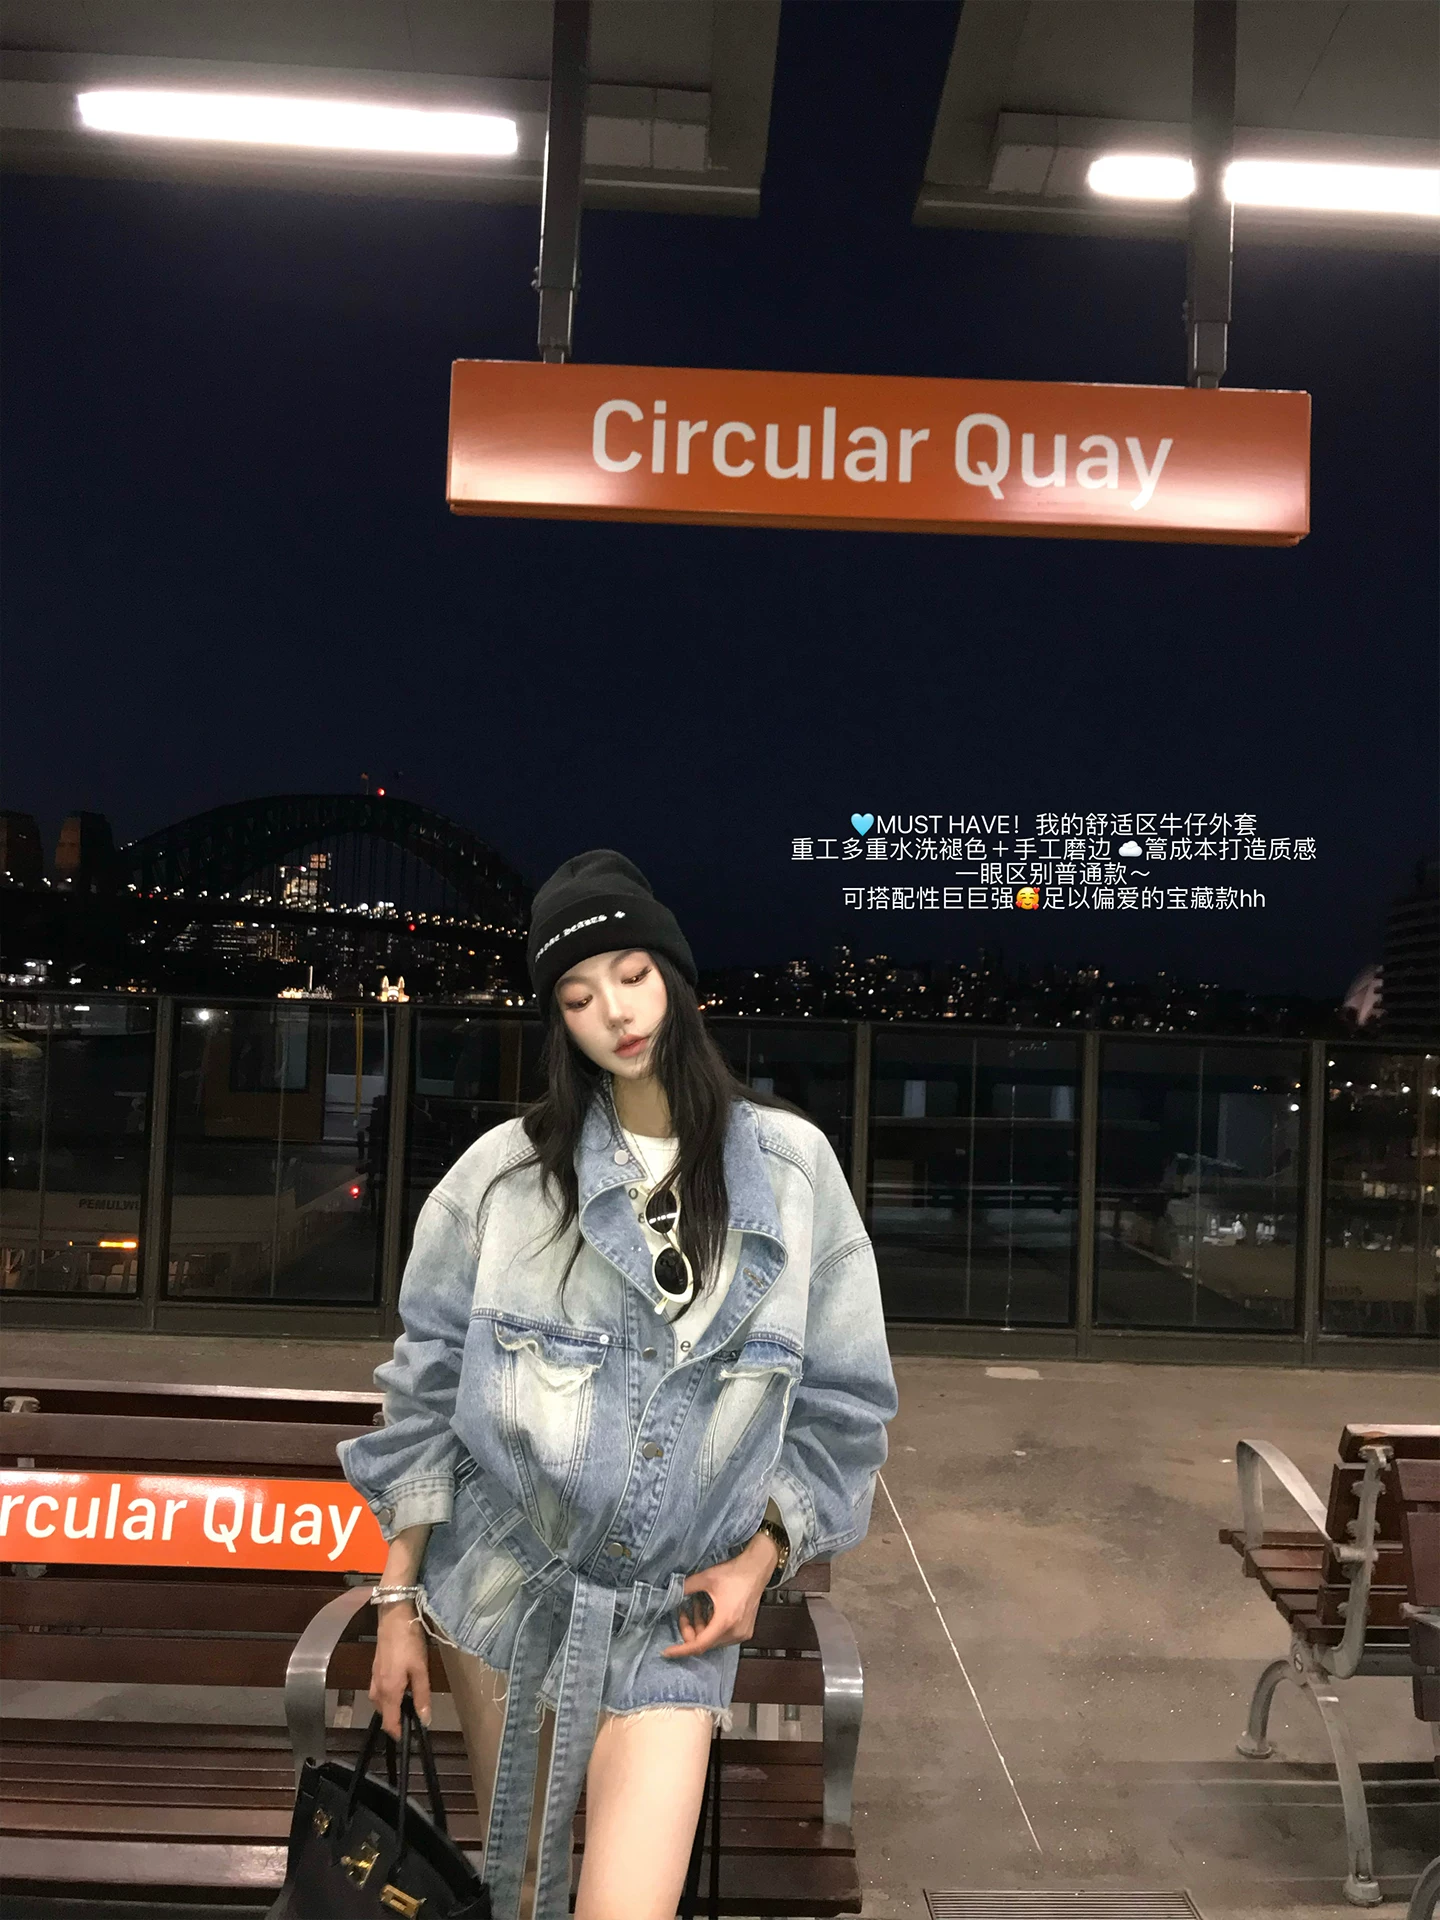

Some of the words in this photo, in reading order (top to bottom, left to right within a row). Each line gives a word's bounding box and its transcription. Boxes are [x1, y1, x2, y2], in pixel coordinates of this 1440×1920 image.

[591, 399, 930, 484] Circular
[955, 413, 1174, 511] Quay
[0, 1483, 188, 1541] rcular
[203, 1486, 363, 1561] Quay
